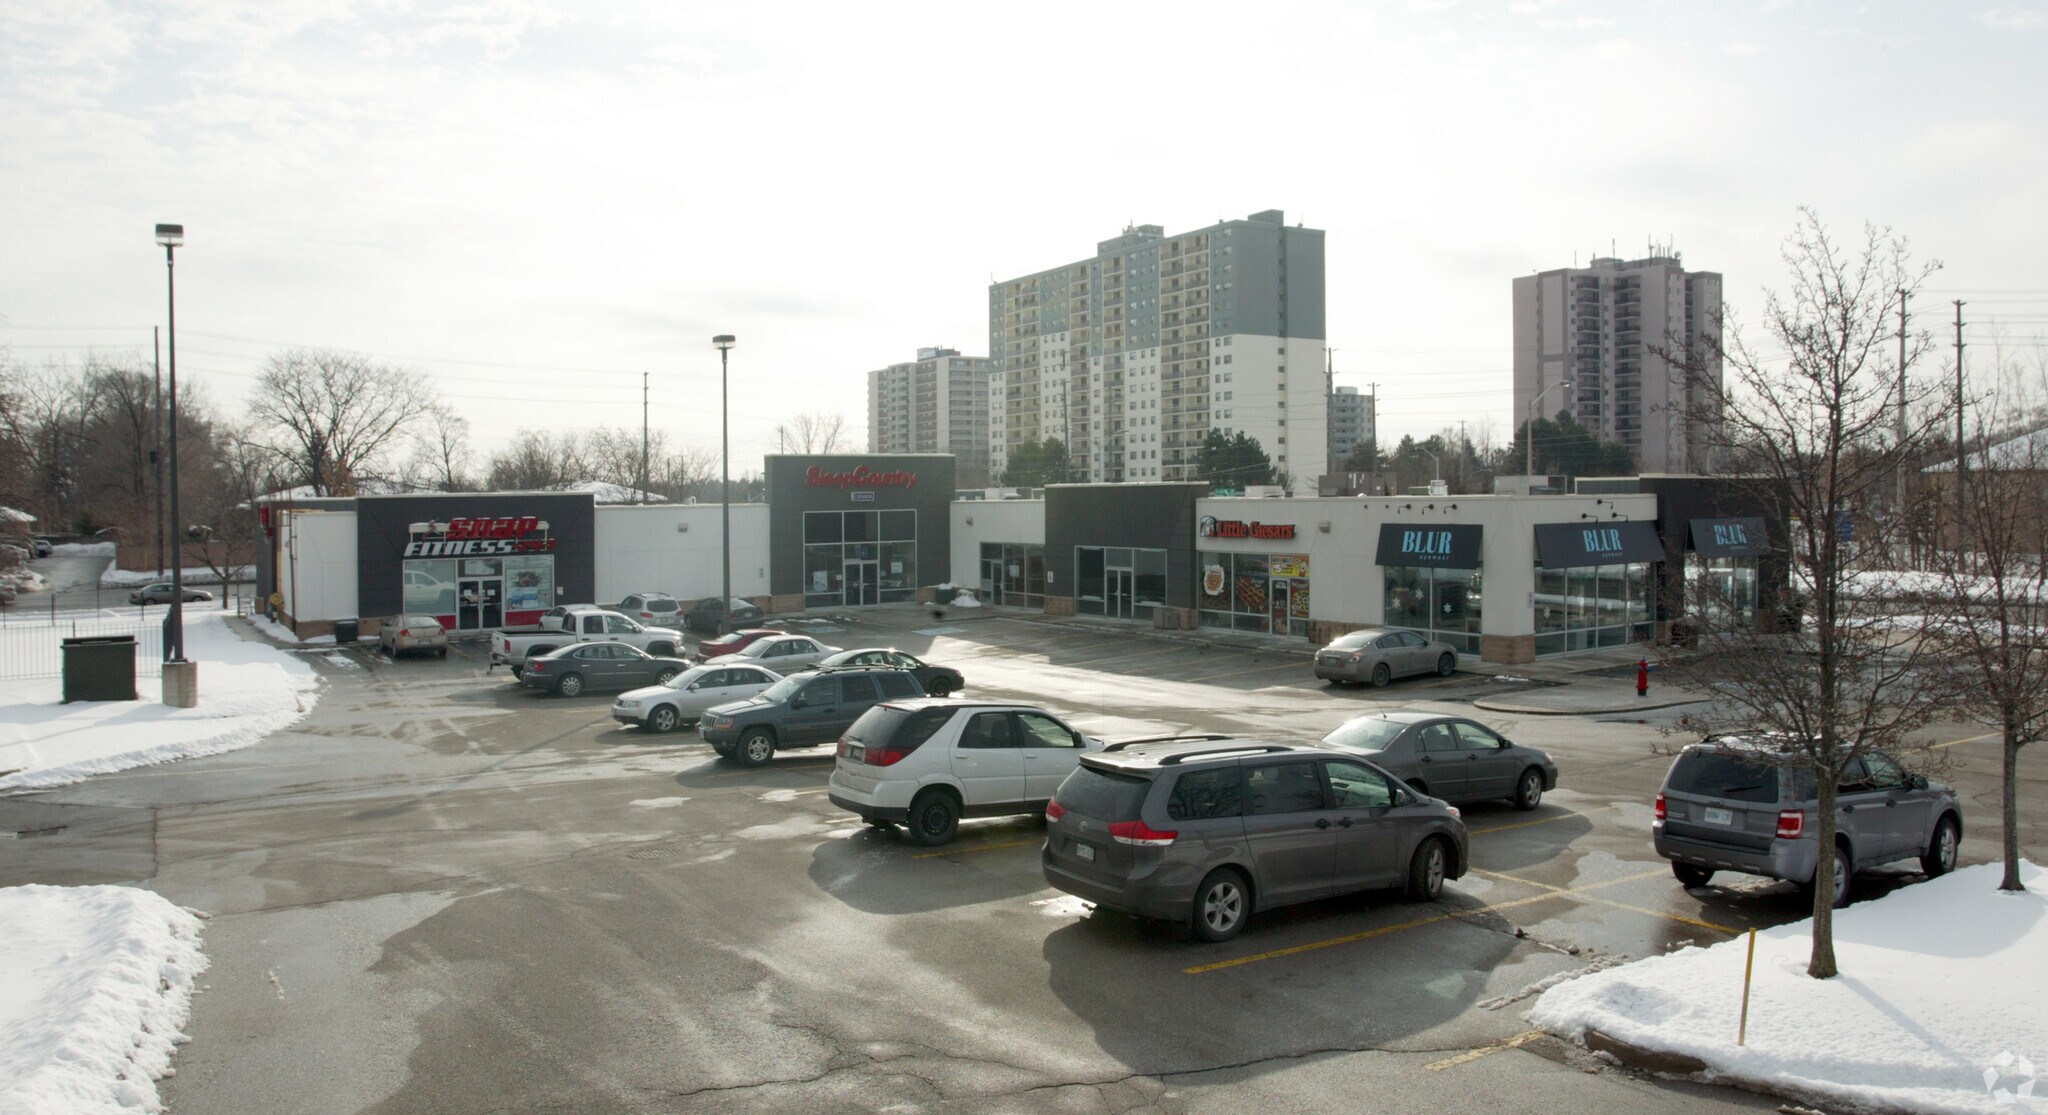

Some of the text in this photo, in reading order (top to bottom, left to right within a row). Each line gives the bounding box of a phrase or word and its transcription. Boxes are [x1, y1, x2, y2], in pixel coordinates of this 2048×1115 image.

[1217, 521, 1295, 539] Little Caesars
[1582, 528, 1623, 552] BLUR
[1714, 524, 1747, 545] BLUR
[1401, 531, 1453, 553] BLUR
